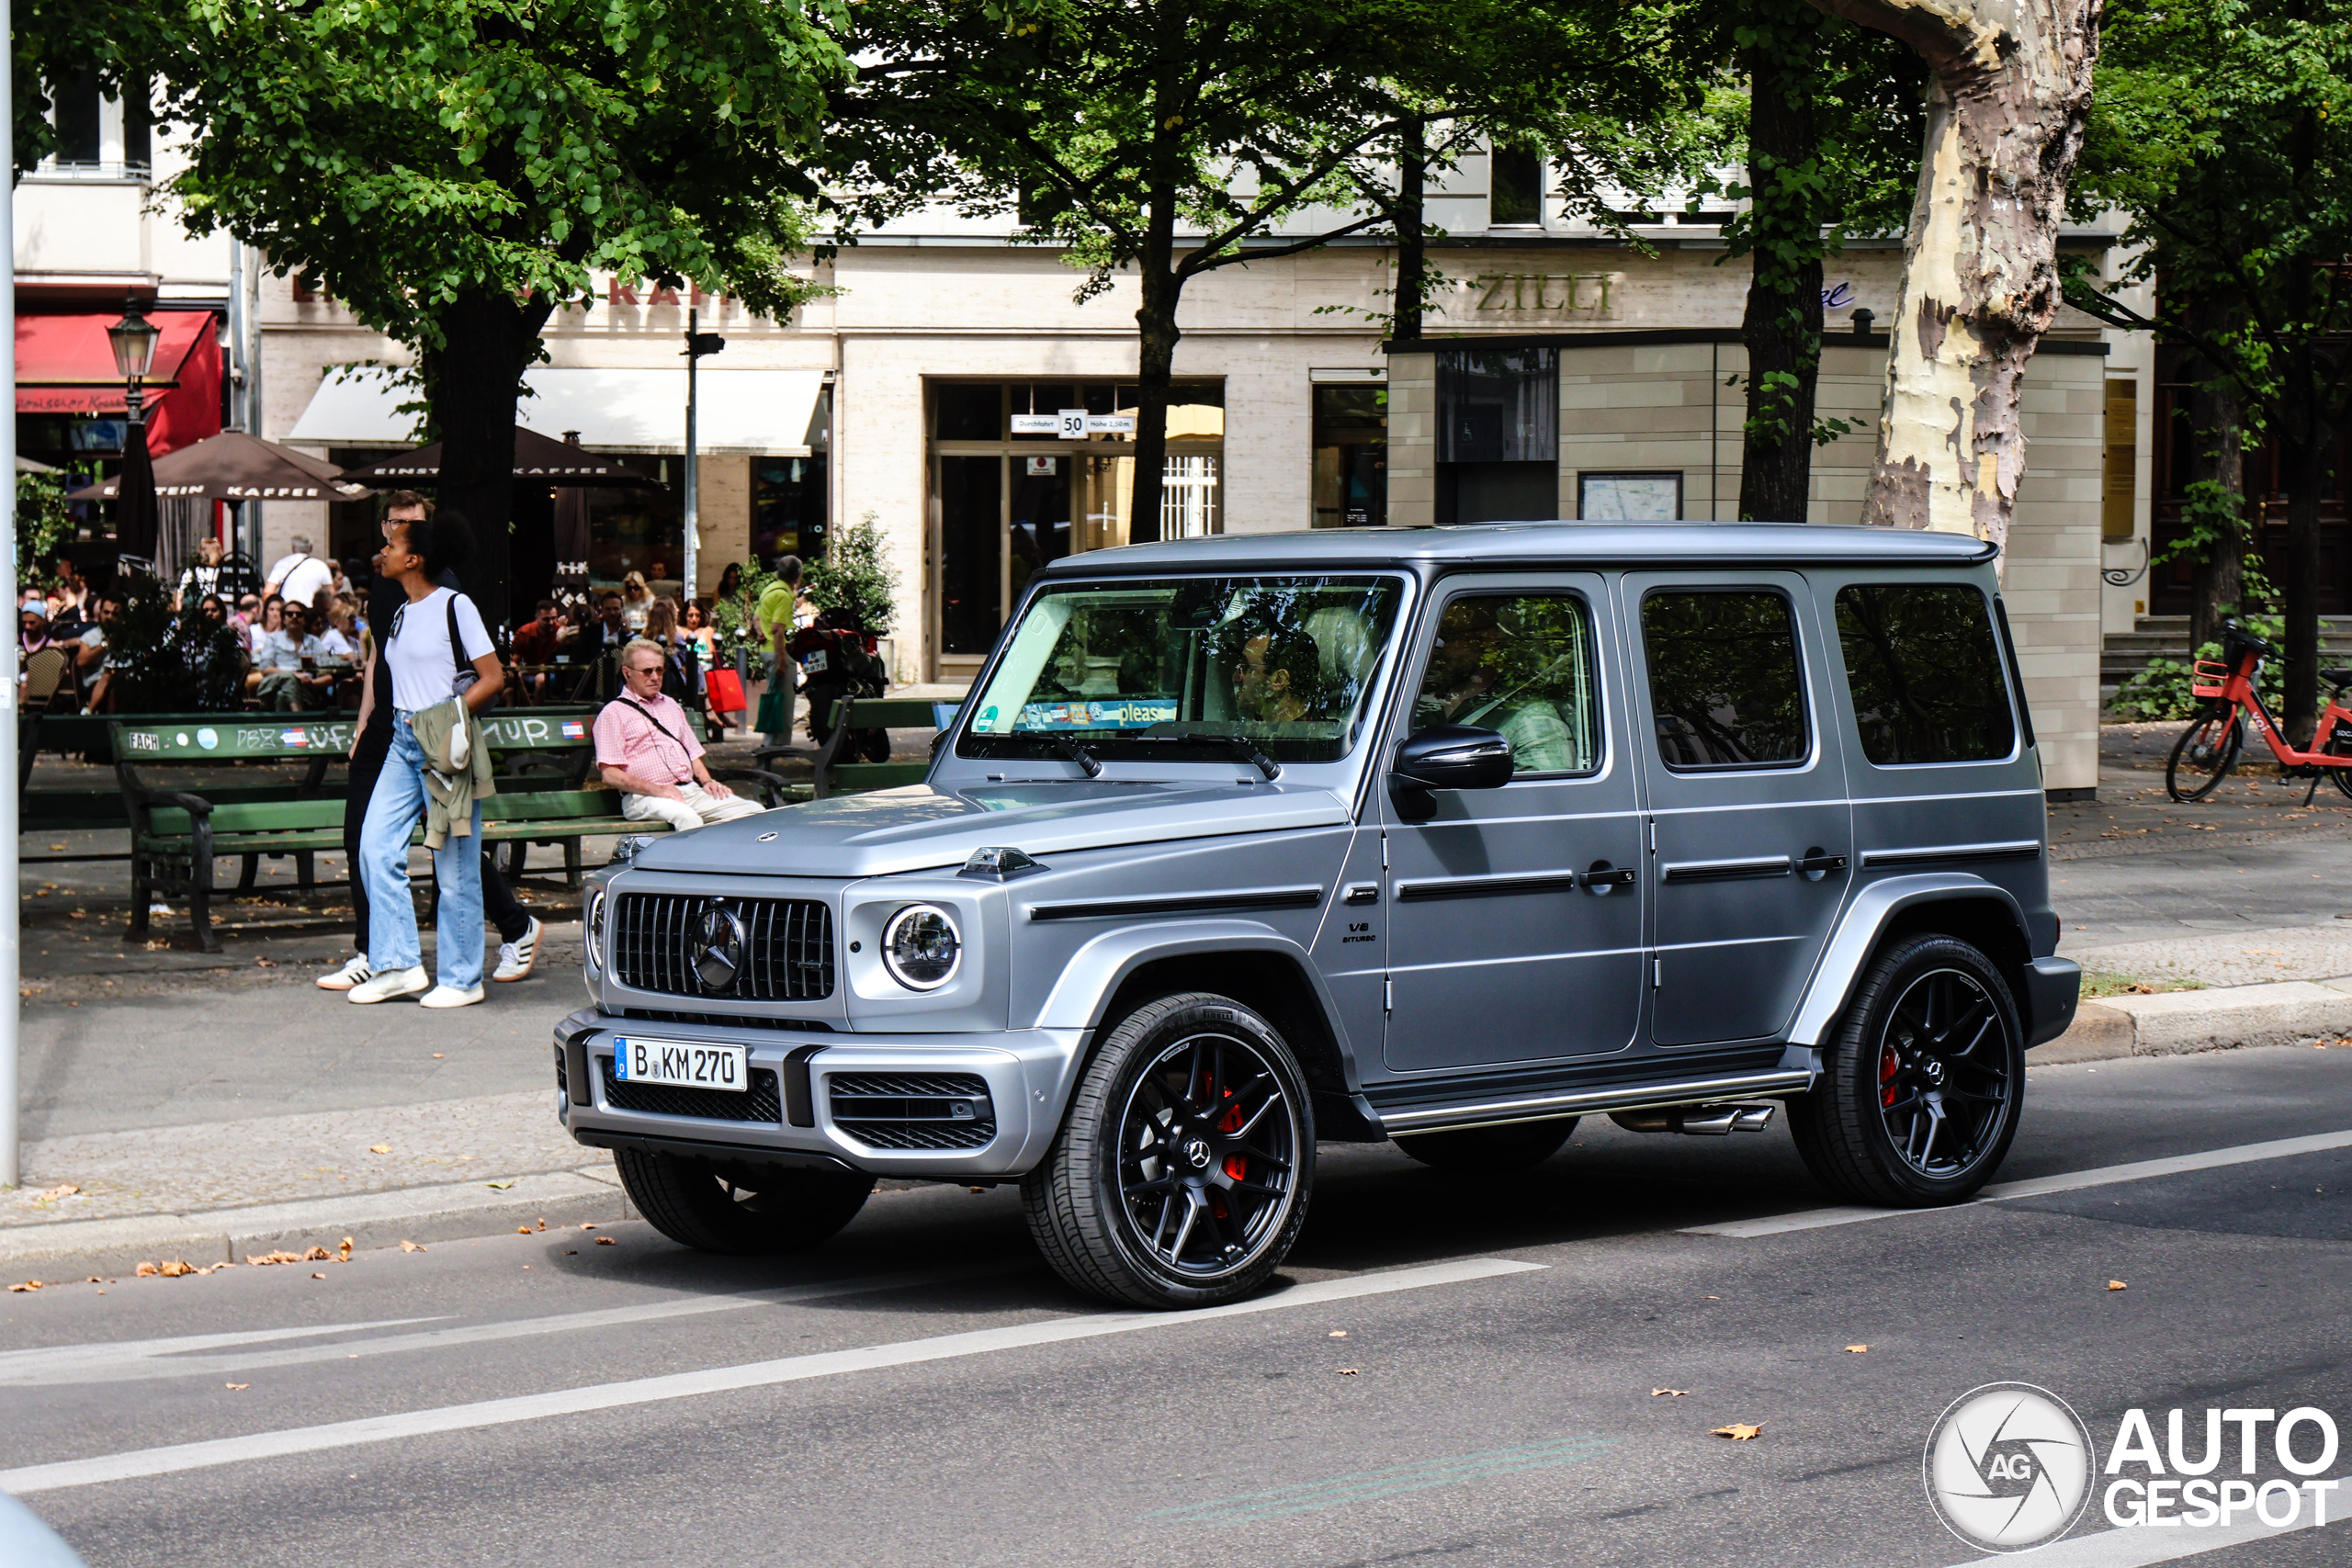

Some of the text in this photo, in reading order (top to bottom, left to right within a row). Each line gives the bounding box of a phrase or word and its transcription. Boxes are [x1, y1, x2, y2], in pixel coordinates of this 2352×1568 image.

[1476, 274, 1613, 310] ZILLI
[1064, 417, 1082, 431] 50
[1517, 423, 1535, 437] WC
[374, 467, 607, 476] EINST KAFFEE
[103, 484, 320, 498] ETEIN KAFFEE
[1118, 703, 1166, 727] please
[130, 734, 158, 750] FACH
[1349, 922, 1369, 932] V8
[1342, 934, 1376, 943] BITURBO
[1939, 947, 1993, 975] CORPION
[618, 1063, 625, 1073] D
[634, 1044, 735, 1084] B KM 270
